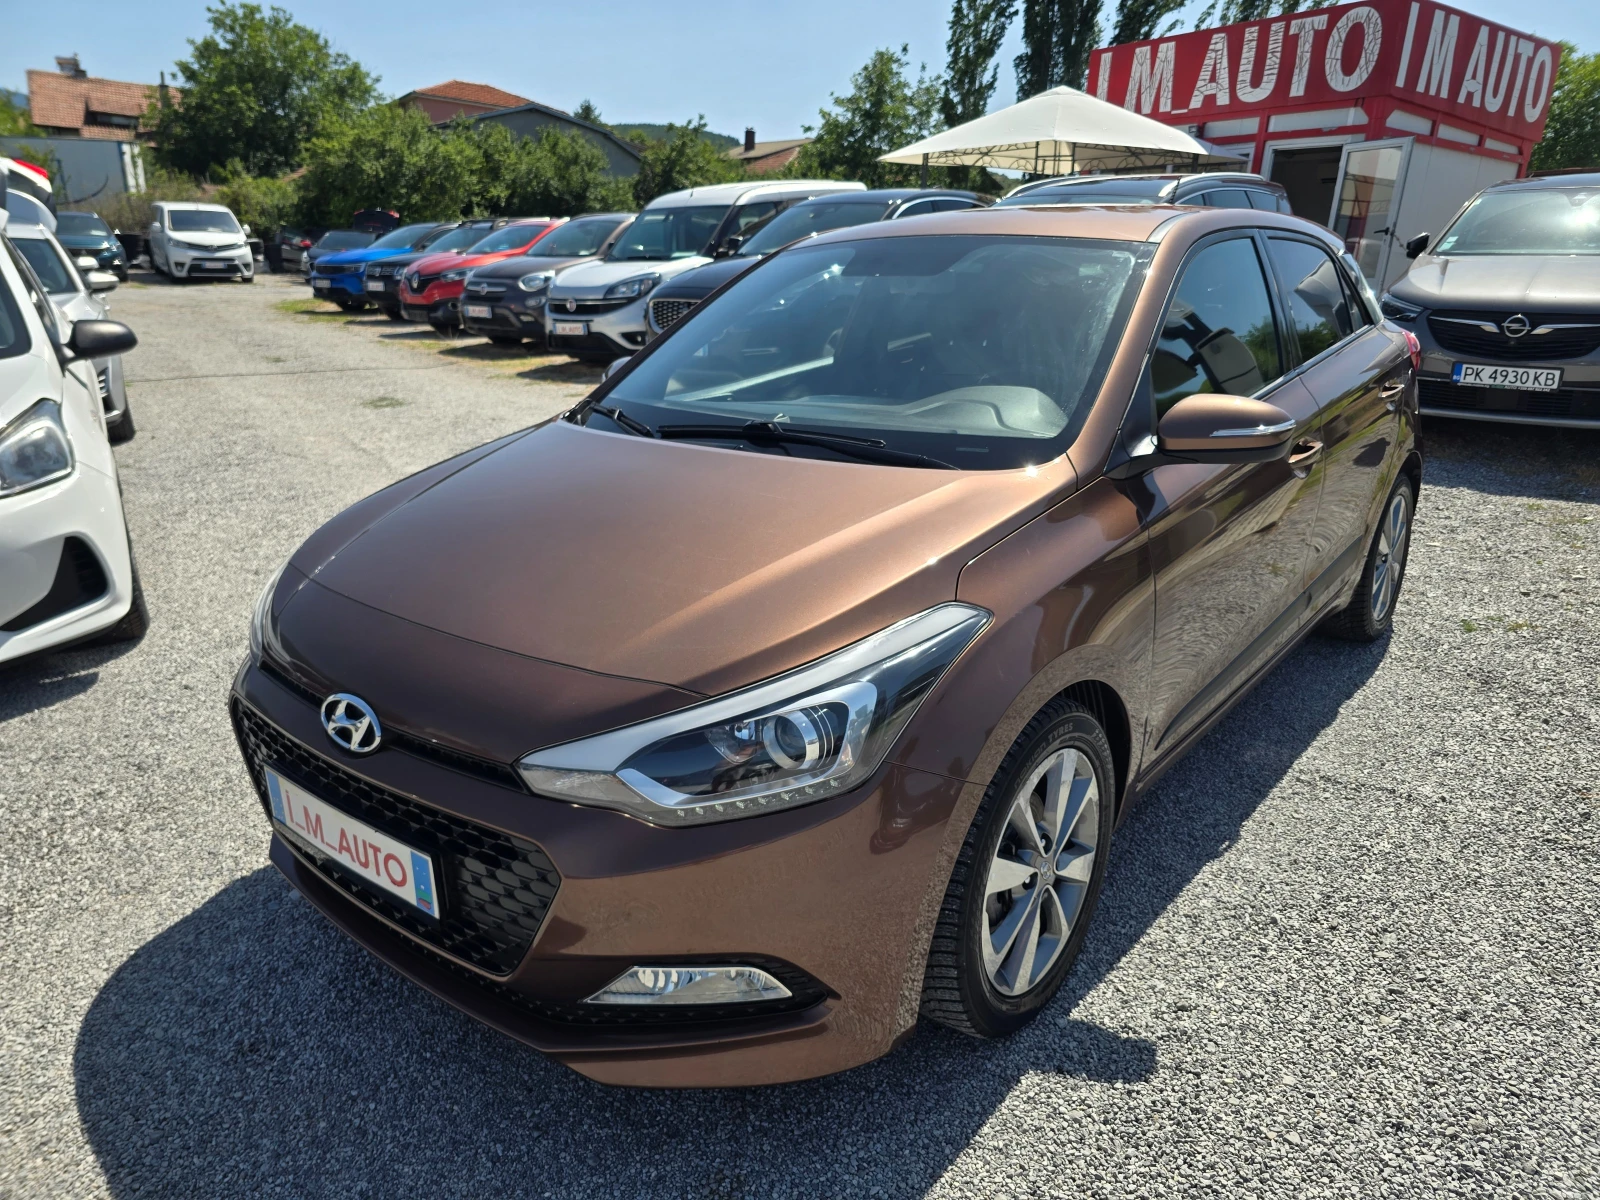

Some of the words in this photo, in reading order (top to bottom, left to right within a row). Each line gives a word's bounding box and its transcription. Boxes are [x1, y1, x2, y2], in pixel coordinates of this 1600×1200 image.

[1395, 1, 1420, 88] I
[1457, 24, 1553, 123] AUTO
[1463, 366, 1486, 382] PK
[1488, 368, 1530, 385] 4930
[1532, 371, 1556, 387] KB
[1047, 722, 1074, 743] TYRES
